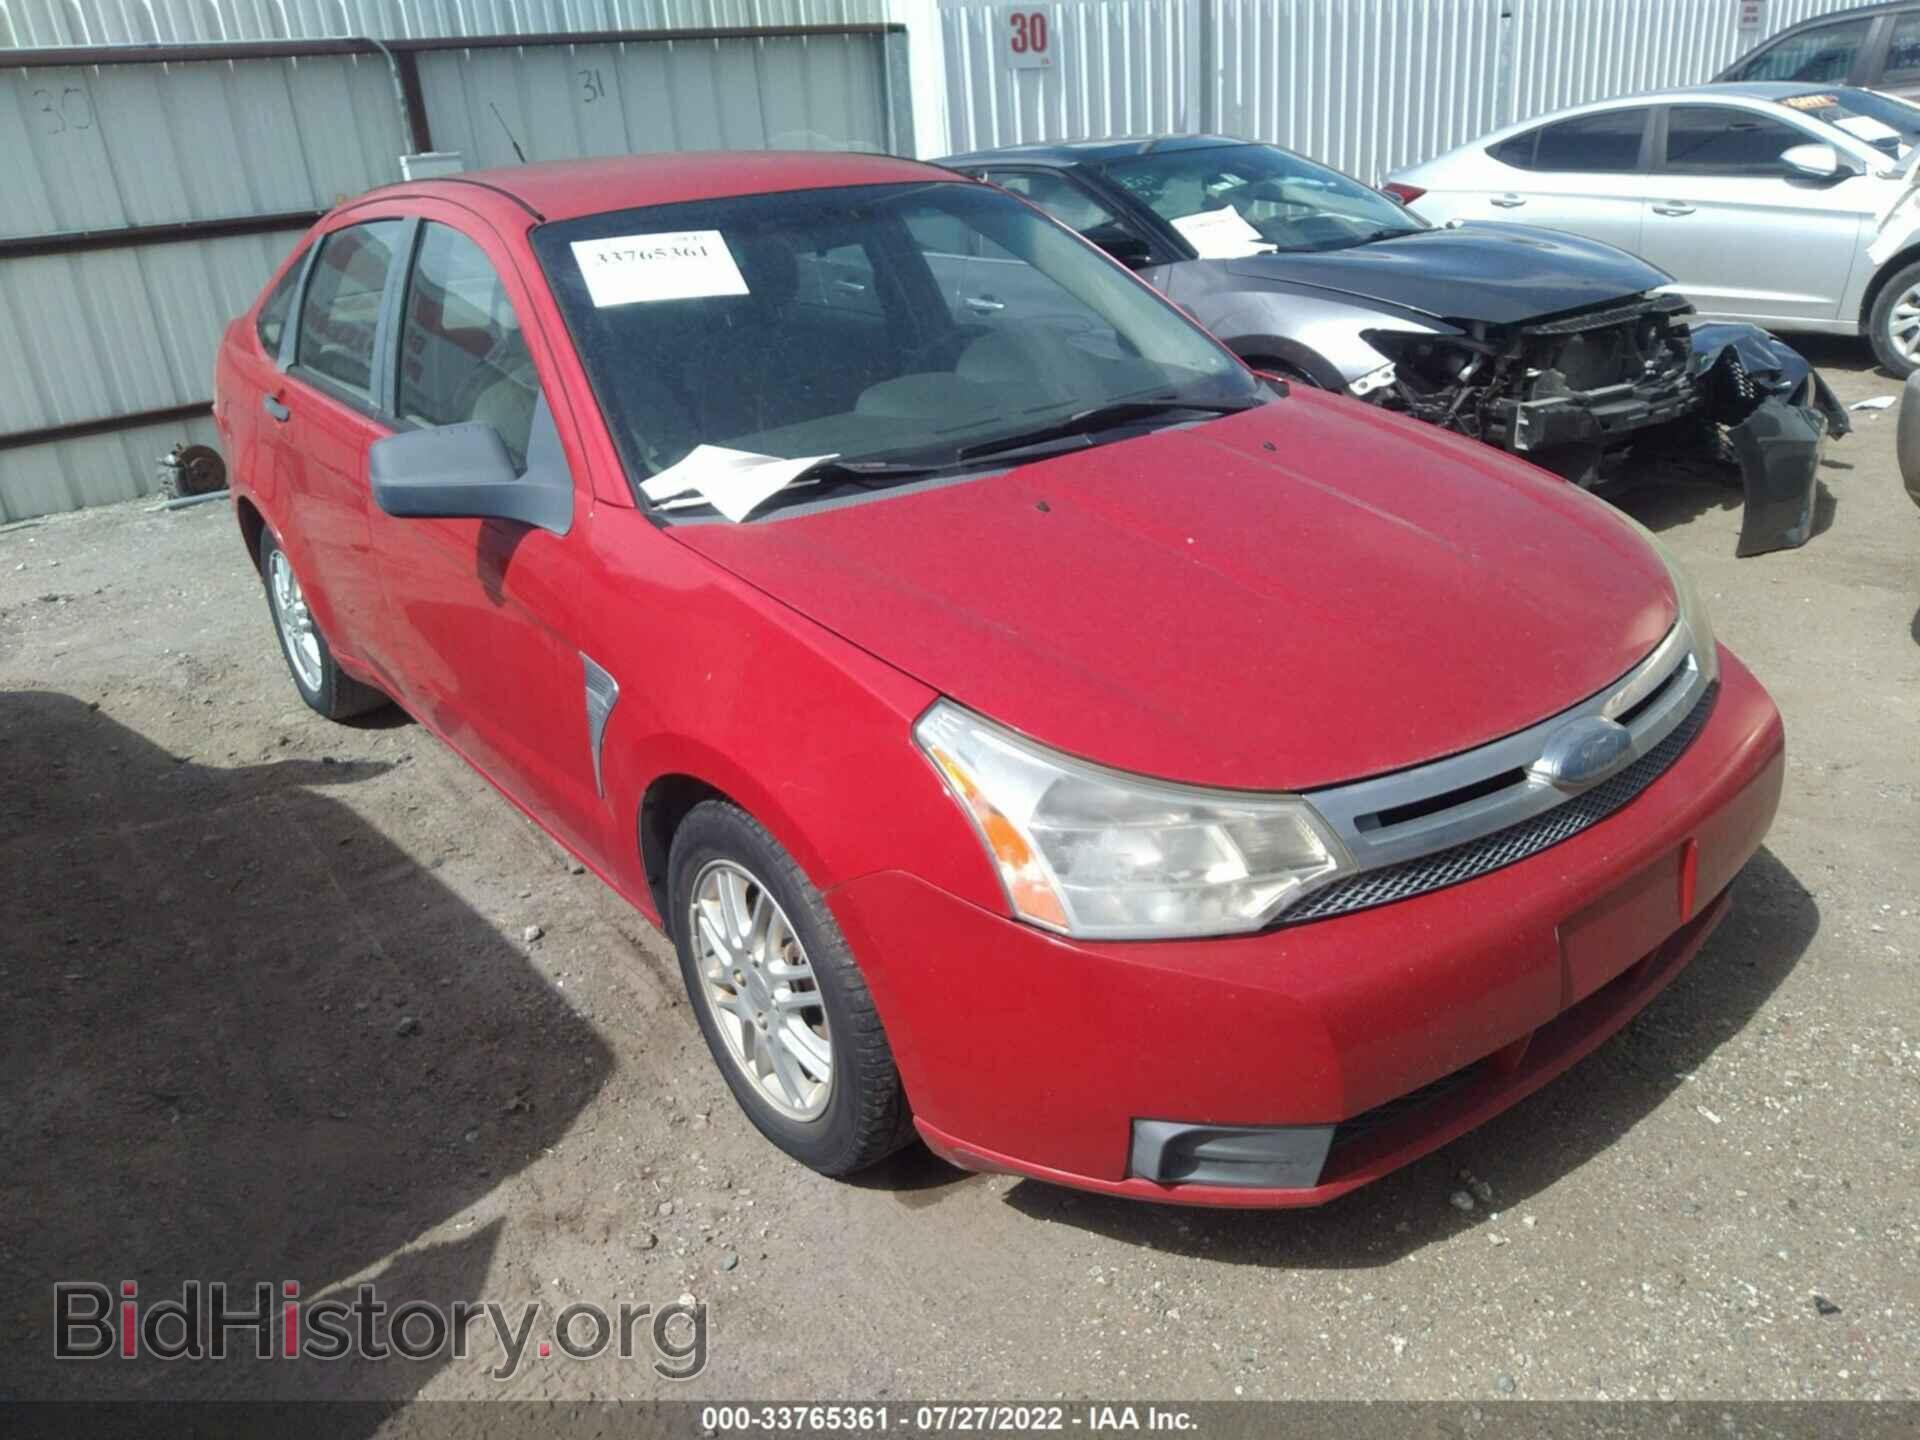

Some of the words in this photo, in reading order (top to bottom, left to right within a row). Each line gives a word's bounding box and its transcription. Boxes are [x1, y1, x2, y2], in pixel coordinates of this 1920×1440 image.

[1010, 12, 1047, 54] 30
[577, 67, 606, 103] 31
[597, 245, 709, 266] 33765361
